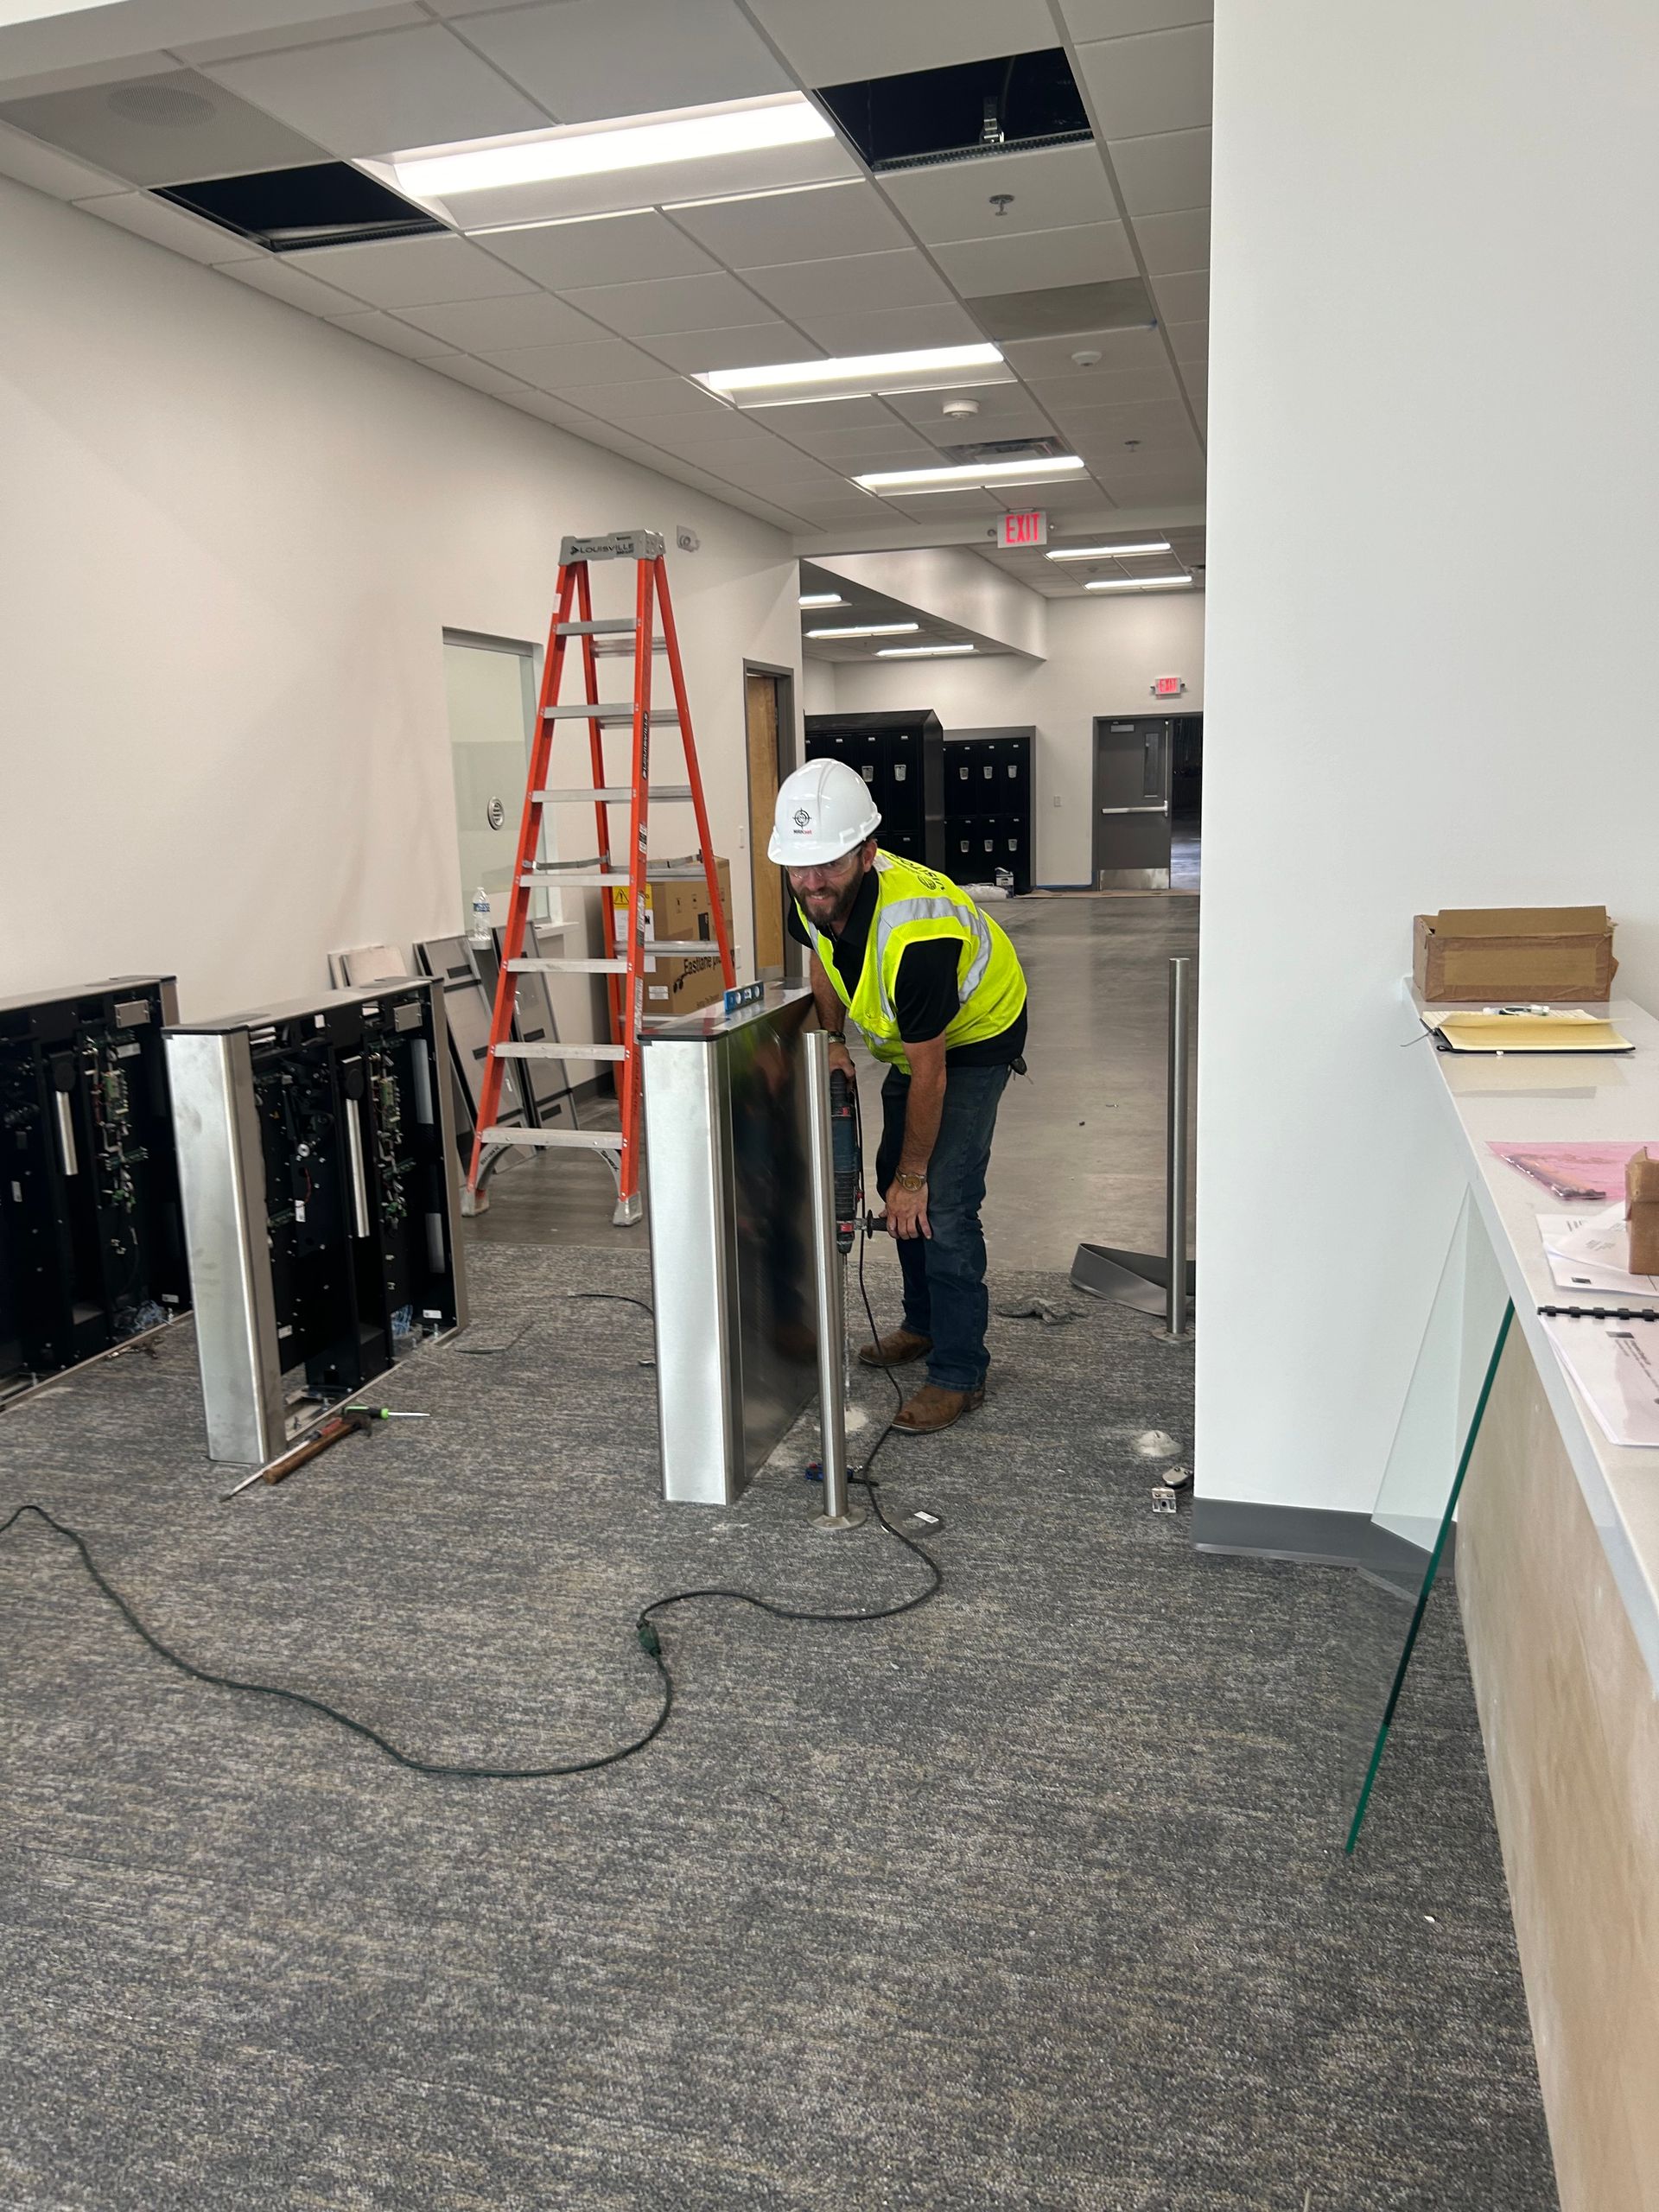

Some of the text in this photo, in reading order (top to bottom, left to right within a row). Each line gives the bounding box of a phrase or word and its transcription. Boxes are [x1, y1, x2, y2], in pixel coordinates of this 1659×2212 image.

[1005, 512, 1040, 543] EXIT
[580, 543, 634, 554] LOUISVILLE
[1159, 677, 1177, 692] EXIT
